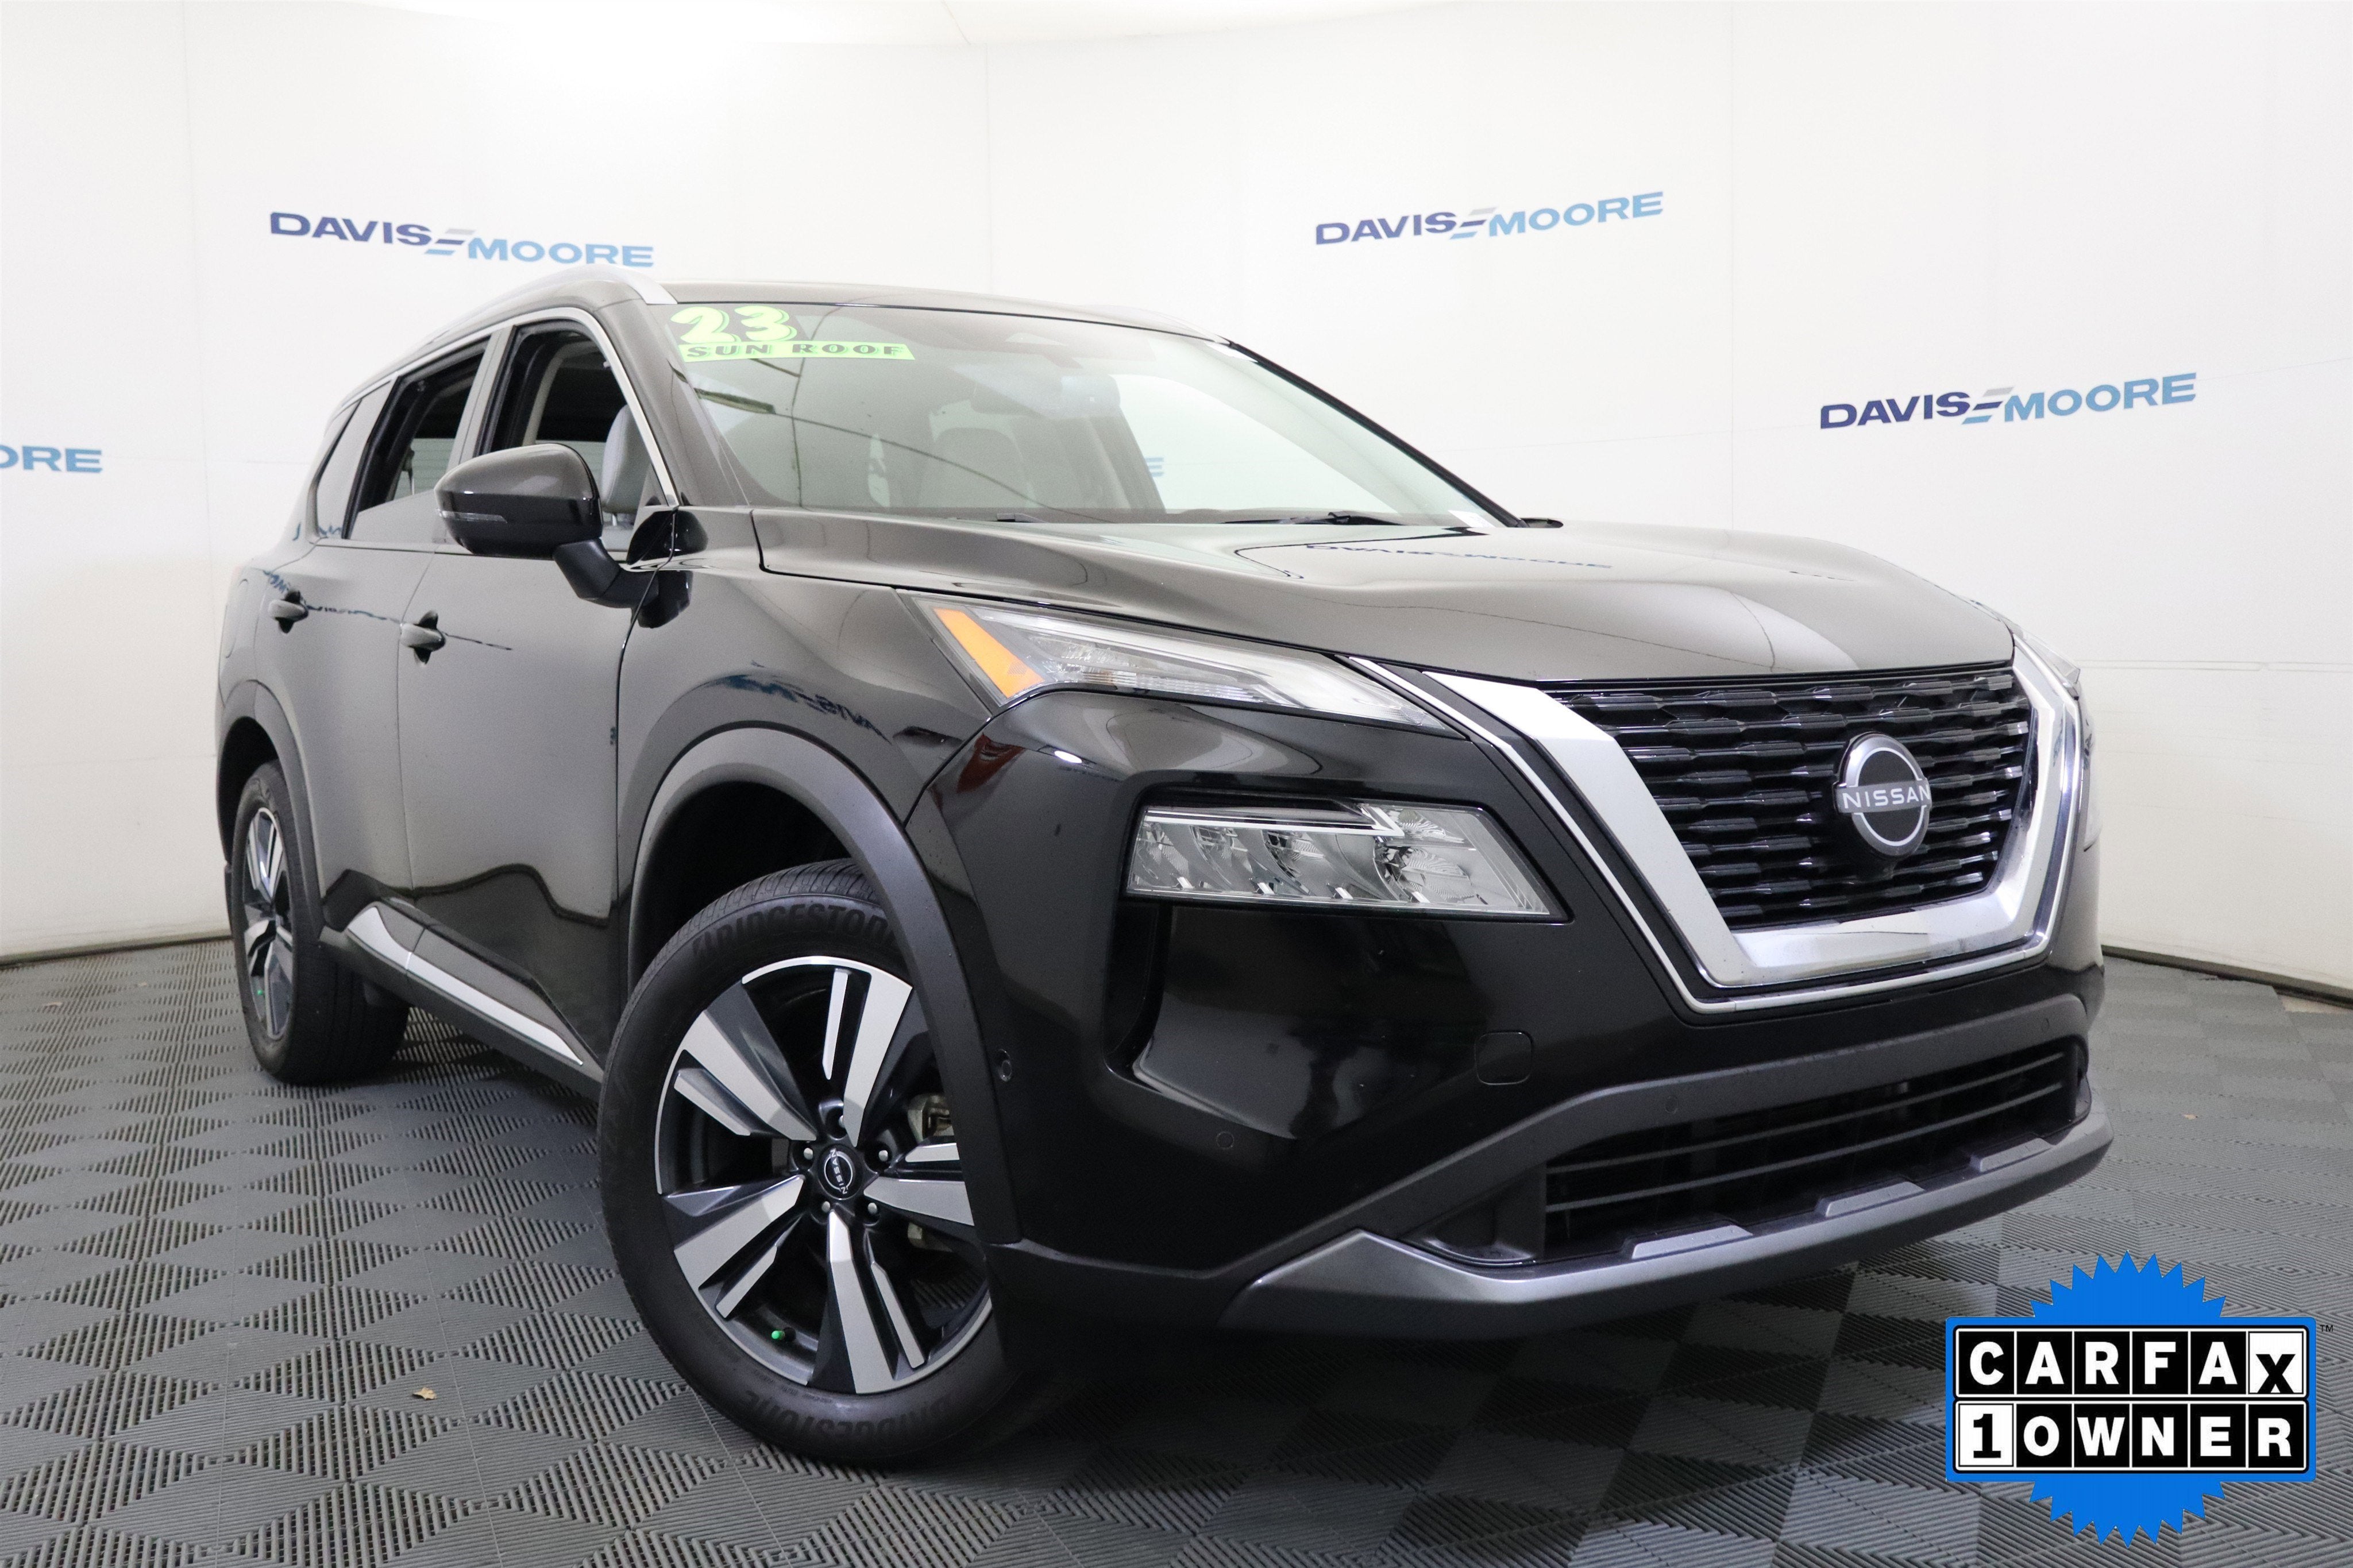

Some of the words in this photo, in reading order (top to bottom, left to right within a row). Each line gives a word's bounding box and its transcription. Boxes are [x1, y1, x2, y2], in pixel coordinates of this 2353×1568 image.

[270, 211, 432, 246] DAVIS
[468, 237, 654, 268] MOORE
[1316, 211, 1457, 245] DAVIS
[1489, 191, 1664, 237] MOORE
[670, 305, 797, 343] 23
[686, 344, 772, 358] SUN
[792, 344, 904, 356] ROOF
[1820, 392, 1970, 429] DAVIS
[2004, 372, 2197, 423] MOORE
[1842, 784, 1931, 809] NISSAN
[692, 902, 896, 958] BRIDGESTON
[830, 1148, 848, 1195] NISSAN
